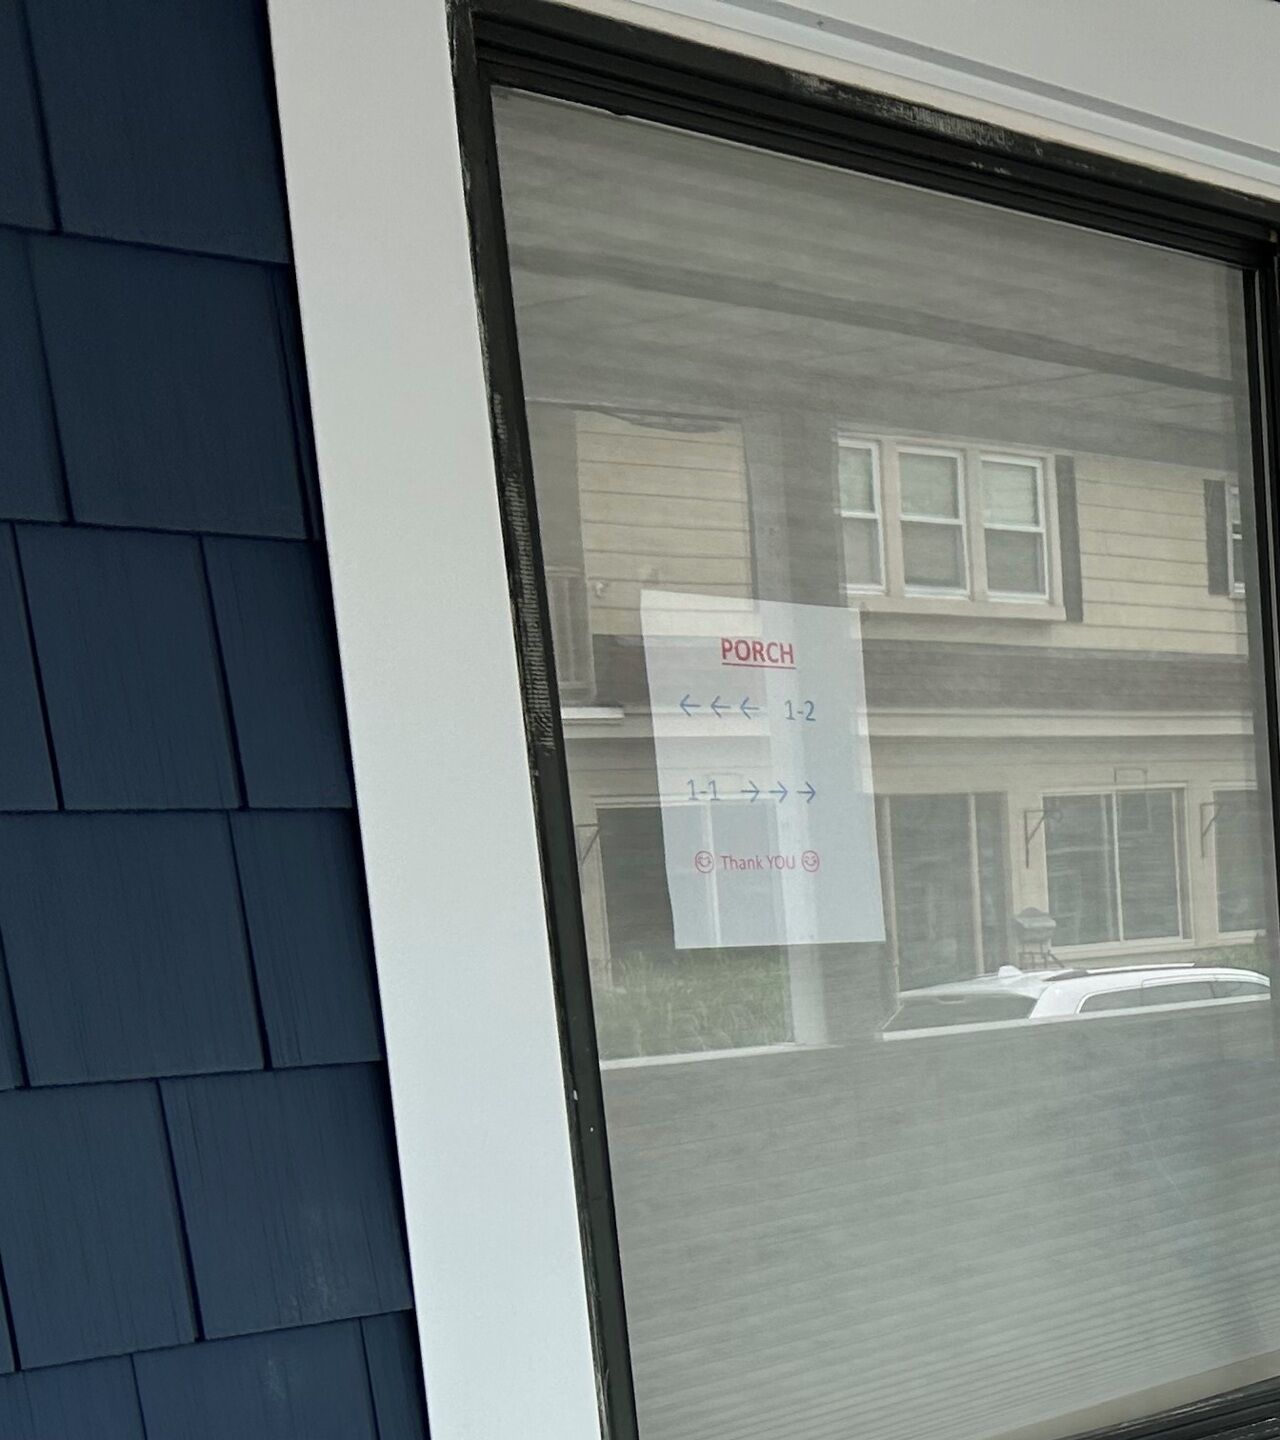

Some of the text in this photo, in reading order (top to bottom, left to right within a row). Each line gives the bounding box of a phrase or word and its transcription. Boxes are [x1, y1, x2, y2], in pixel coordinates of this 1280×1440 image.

[720, 637, 795, 664] PORCH
[784, 700, 816, 722] 1-2
[686, 779, 721, 801] 1-1
[720, 855, 796, 871] Thank YOU
